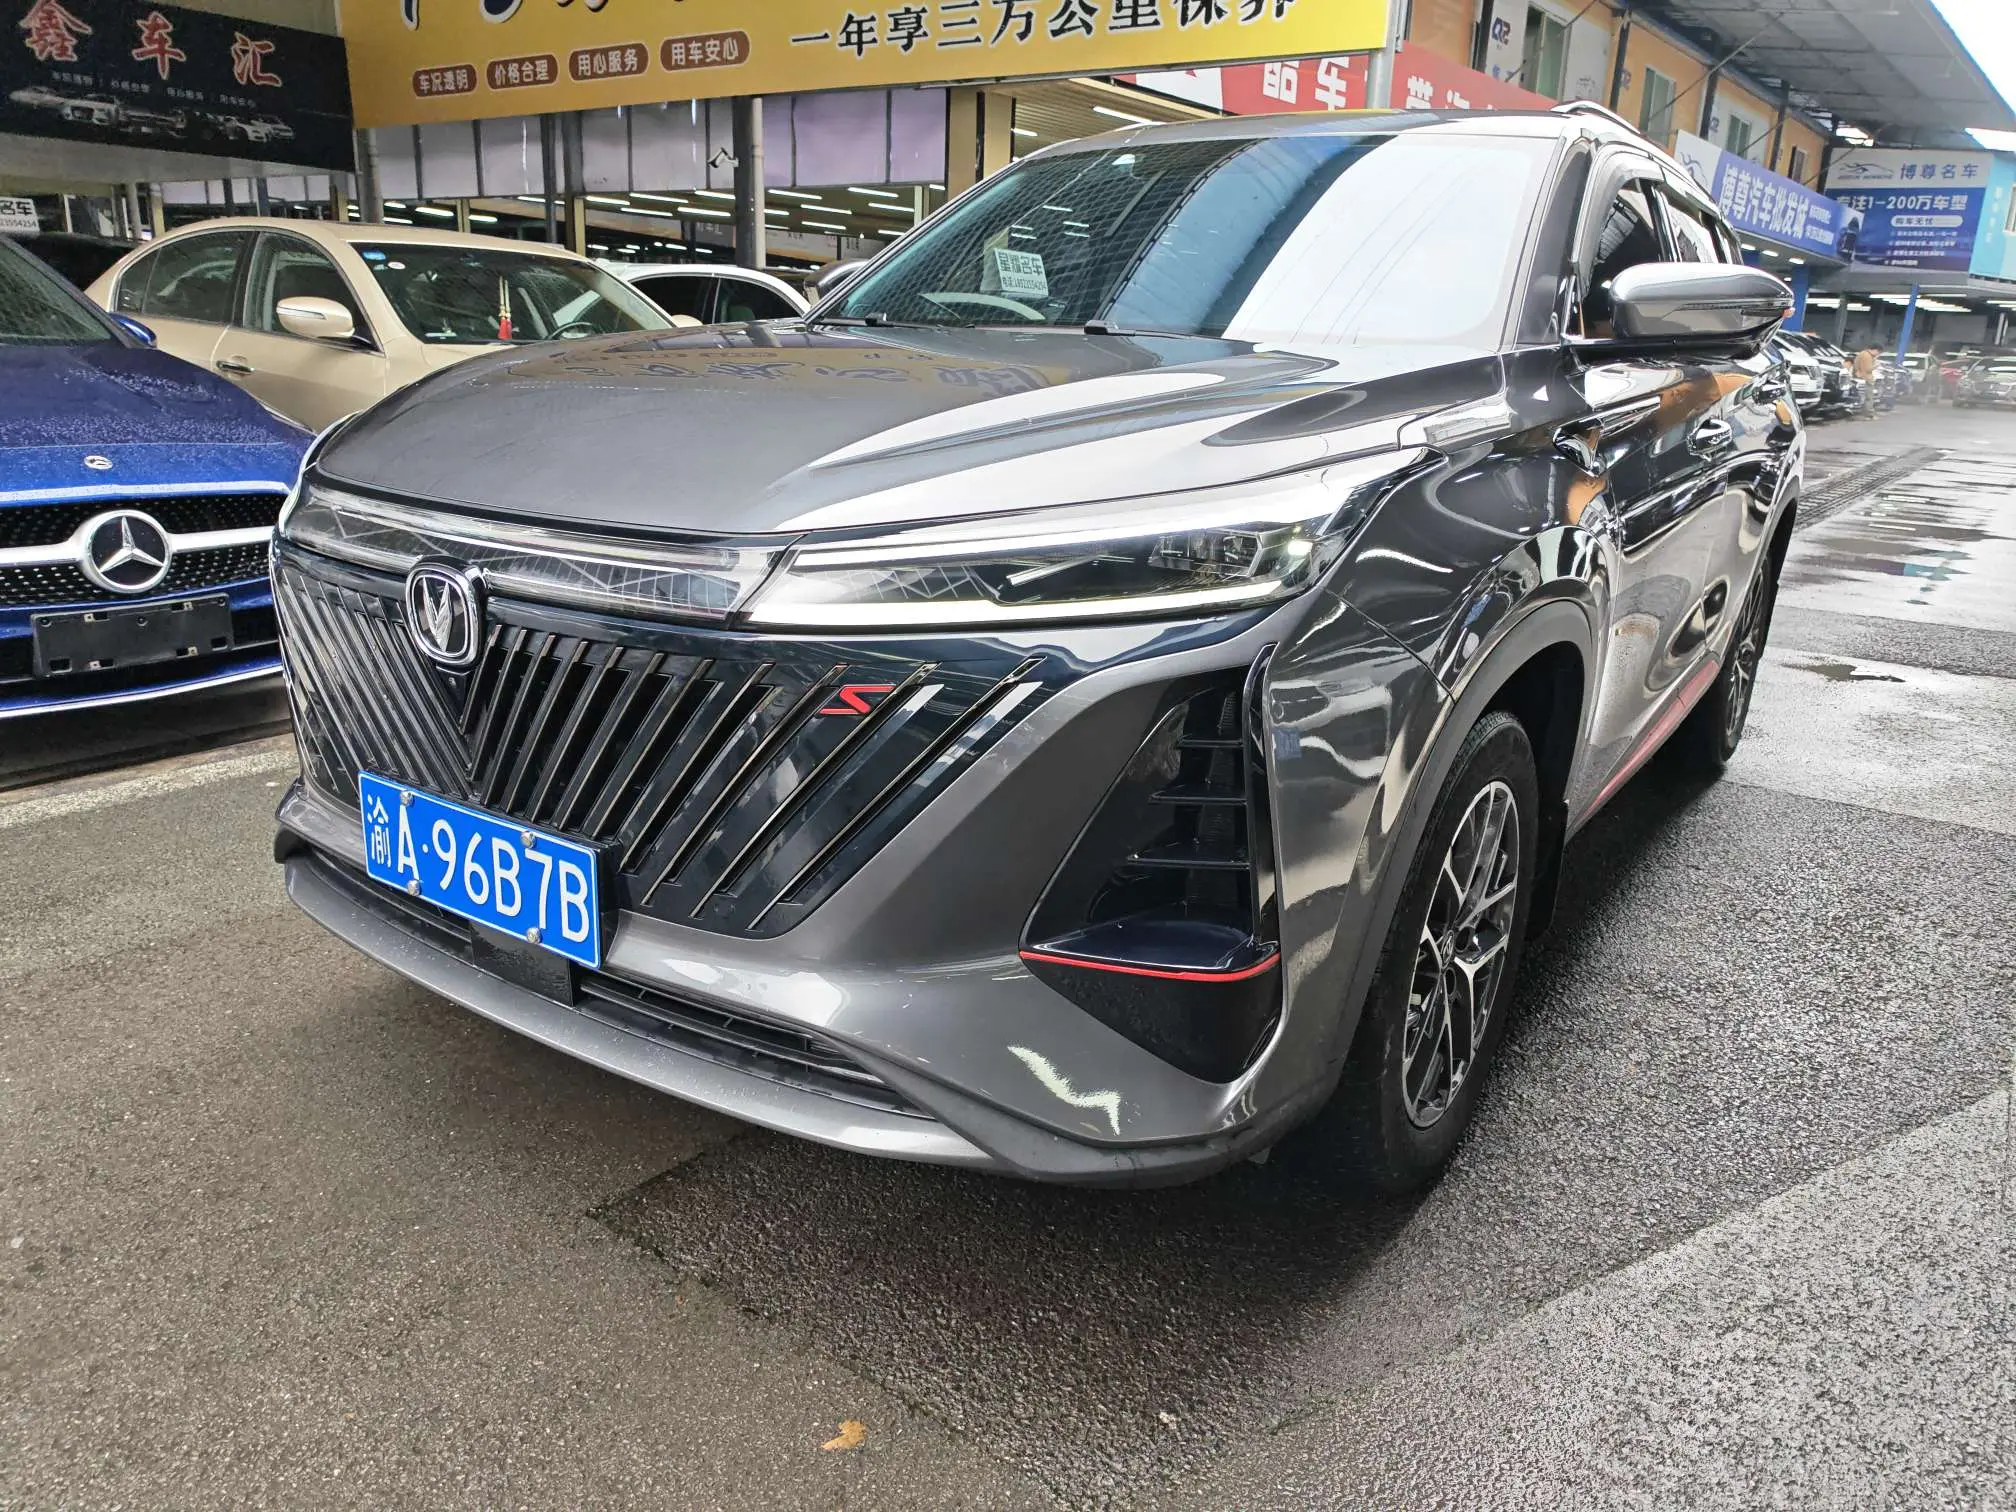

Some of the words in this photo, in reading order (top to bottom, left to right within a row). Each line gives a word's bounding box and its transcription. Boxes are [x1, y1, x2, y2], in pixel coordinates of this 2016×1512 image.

[577, 48, 639, 76] 用心服务
[671, 37, 739, 66] 用车安心
[418, 69, 469, 94] 车况透明
[494, 60, 549, 86] 价格合理
[1900, 163, 1979, 180] 博尊名车
[1718, 163, 1810, 240] 博尊汽车批发城
